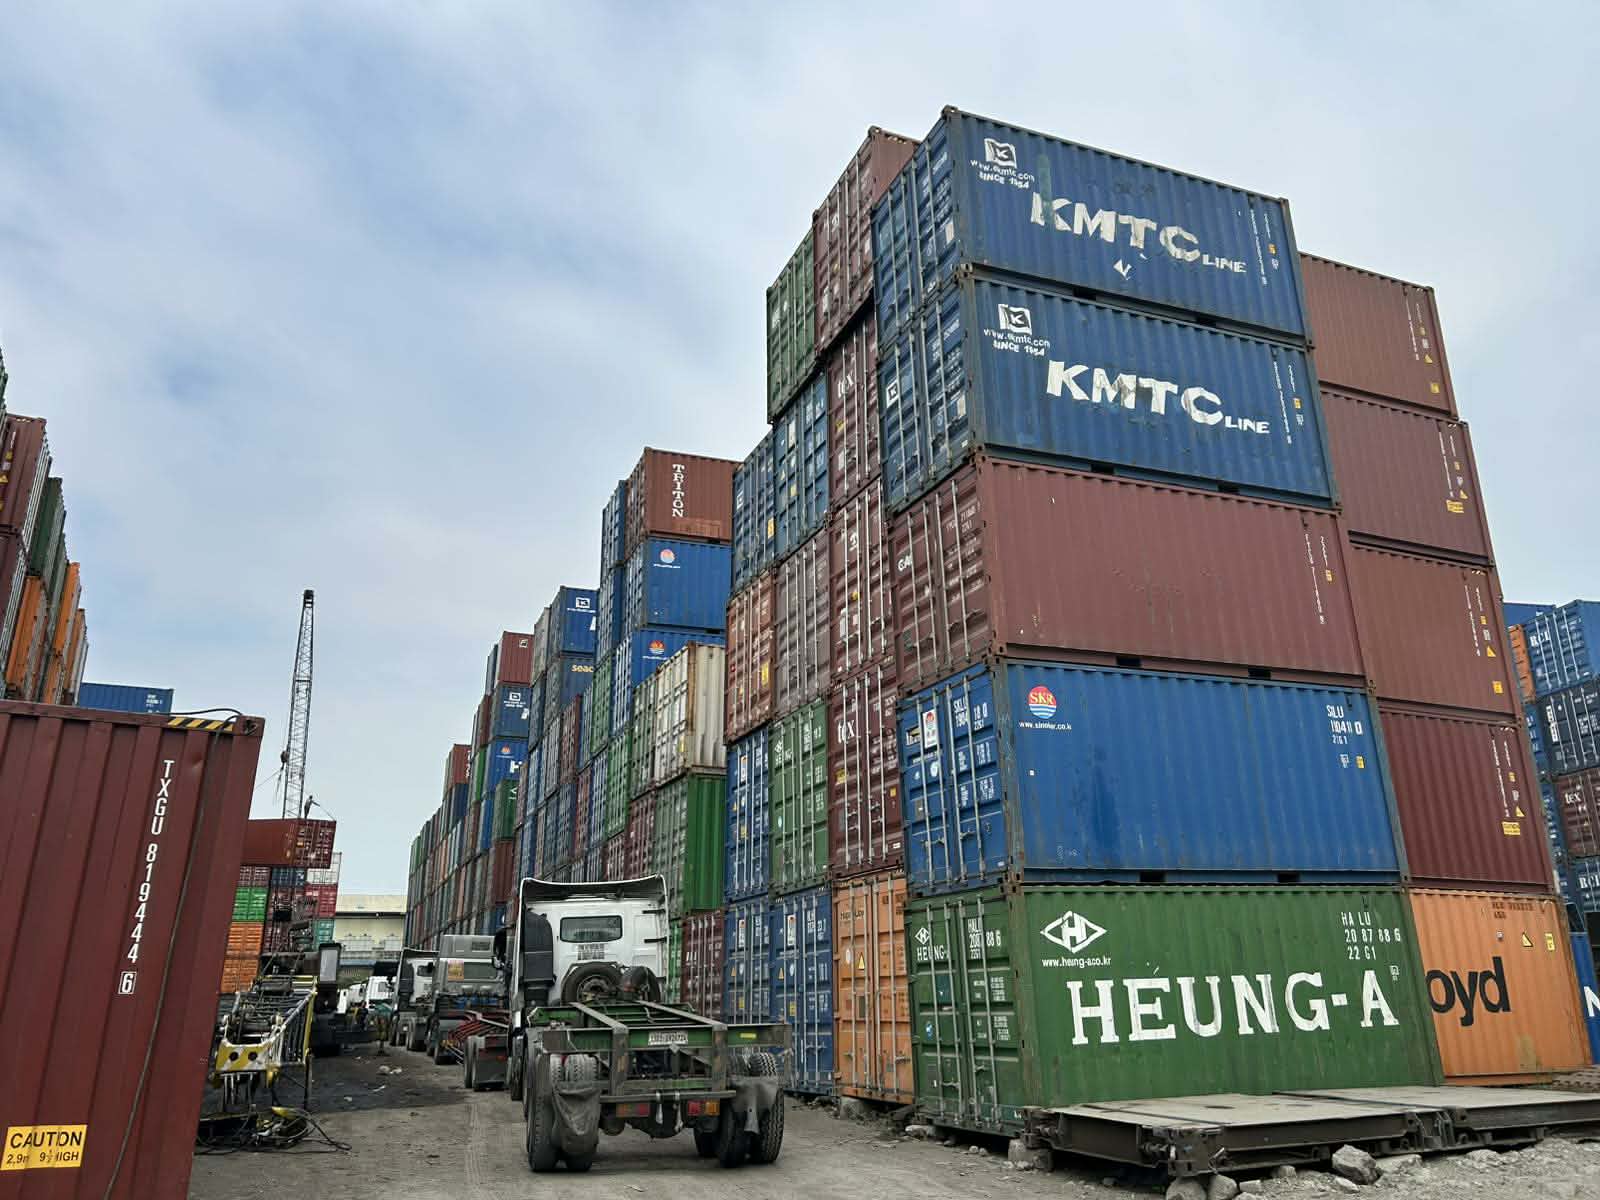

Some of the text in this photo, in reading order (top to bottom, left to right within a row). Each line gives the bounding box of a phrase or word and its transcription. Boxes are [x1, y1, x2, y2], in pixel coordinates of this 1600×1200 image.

[1030, 191, 1201, 263] KMTC
[1202, 254, 1247, 273] LINE
[1046, 359, 1224, 426] KMTC
[1224, 415, 1270, 434] LINE
[671, 463, 685, 517] TRITON
[151, 759, 175, 836] TXGU
[127, 842, 159, 964] 819444
[1066, 970, 1399, 1046] HEUNG-A
[1425, 956, 1511, 1027] oyd
[10, 1130, 83, 1149] CAUTION
